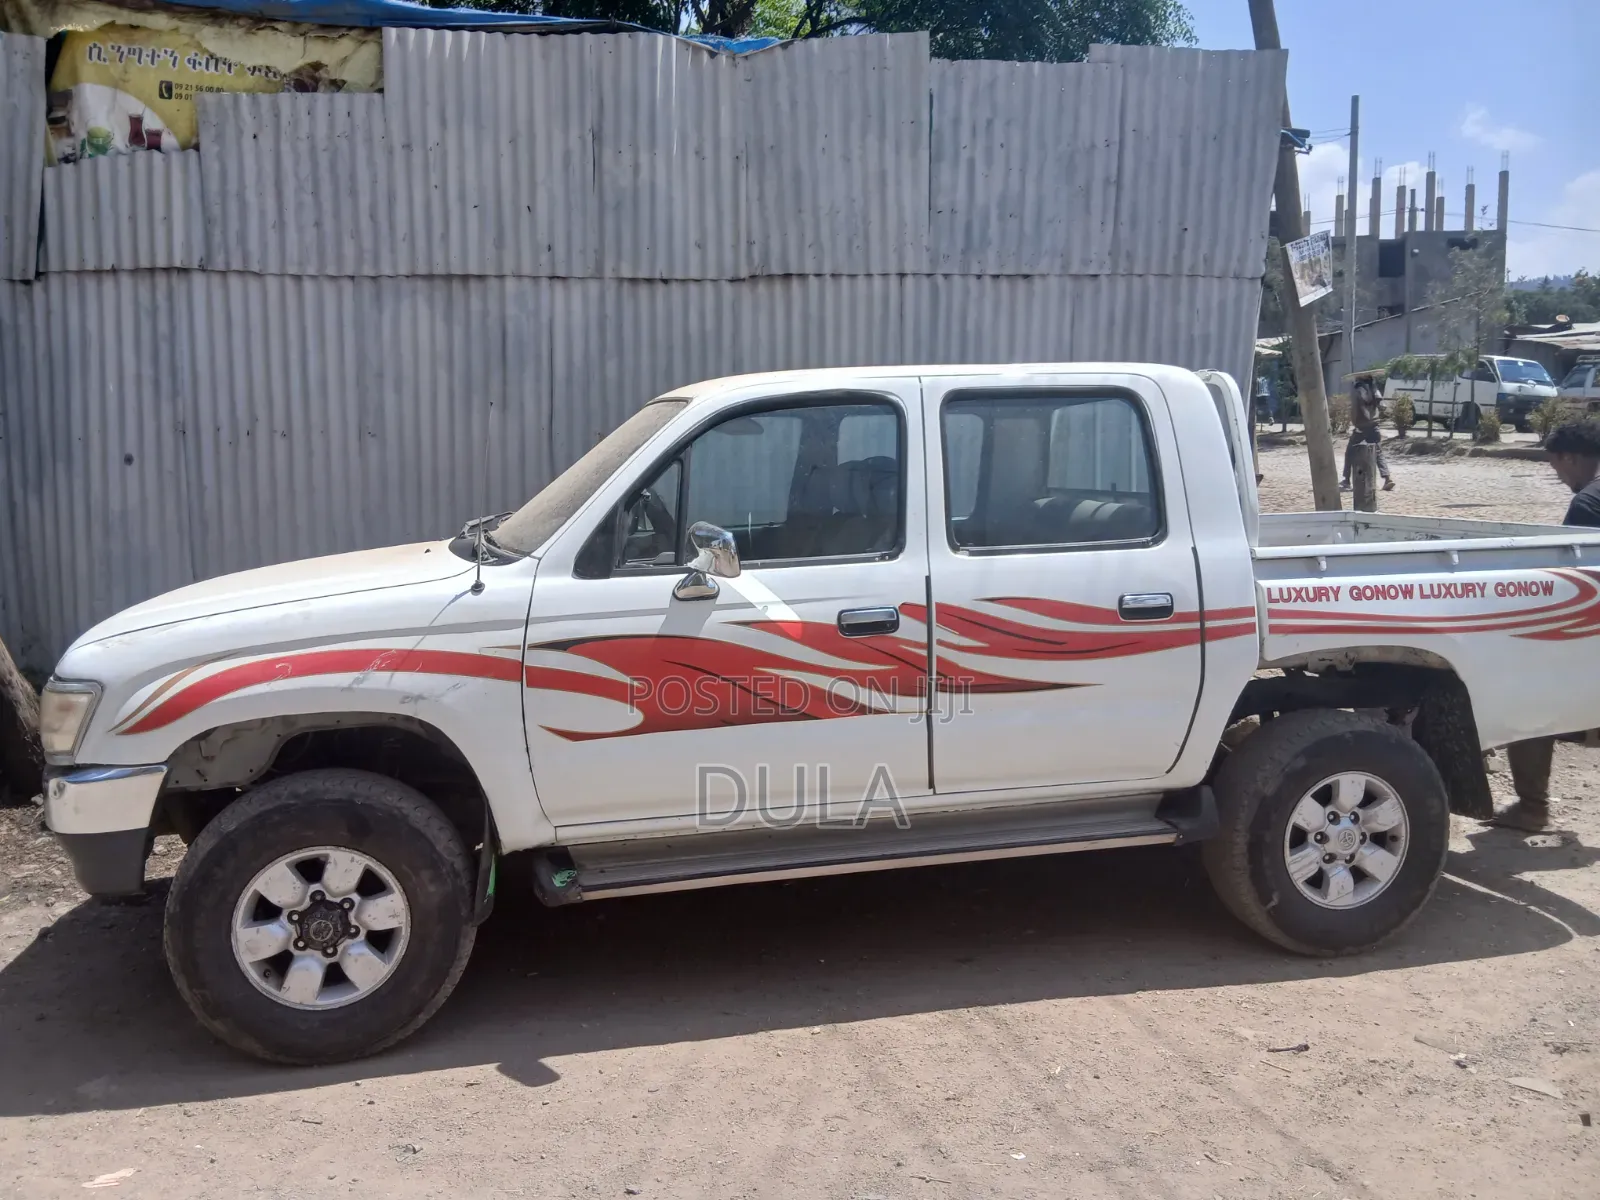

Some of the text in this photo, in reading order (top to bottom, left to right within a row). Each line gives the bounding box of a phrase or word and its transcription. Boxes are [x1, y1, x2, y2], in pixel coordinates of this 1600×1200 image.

[184, 83, 193, 91] 21
[1266, 580, 1555, 604] LUXURY GONOW LUXURY GONOW
